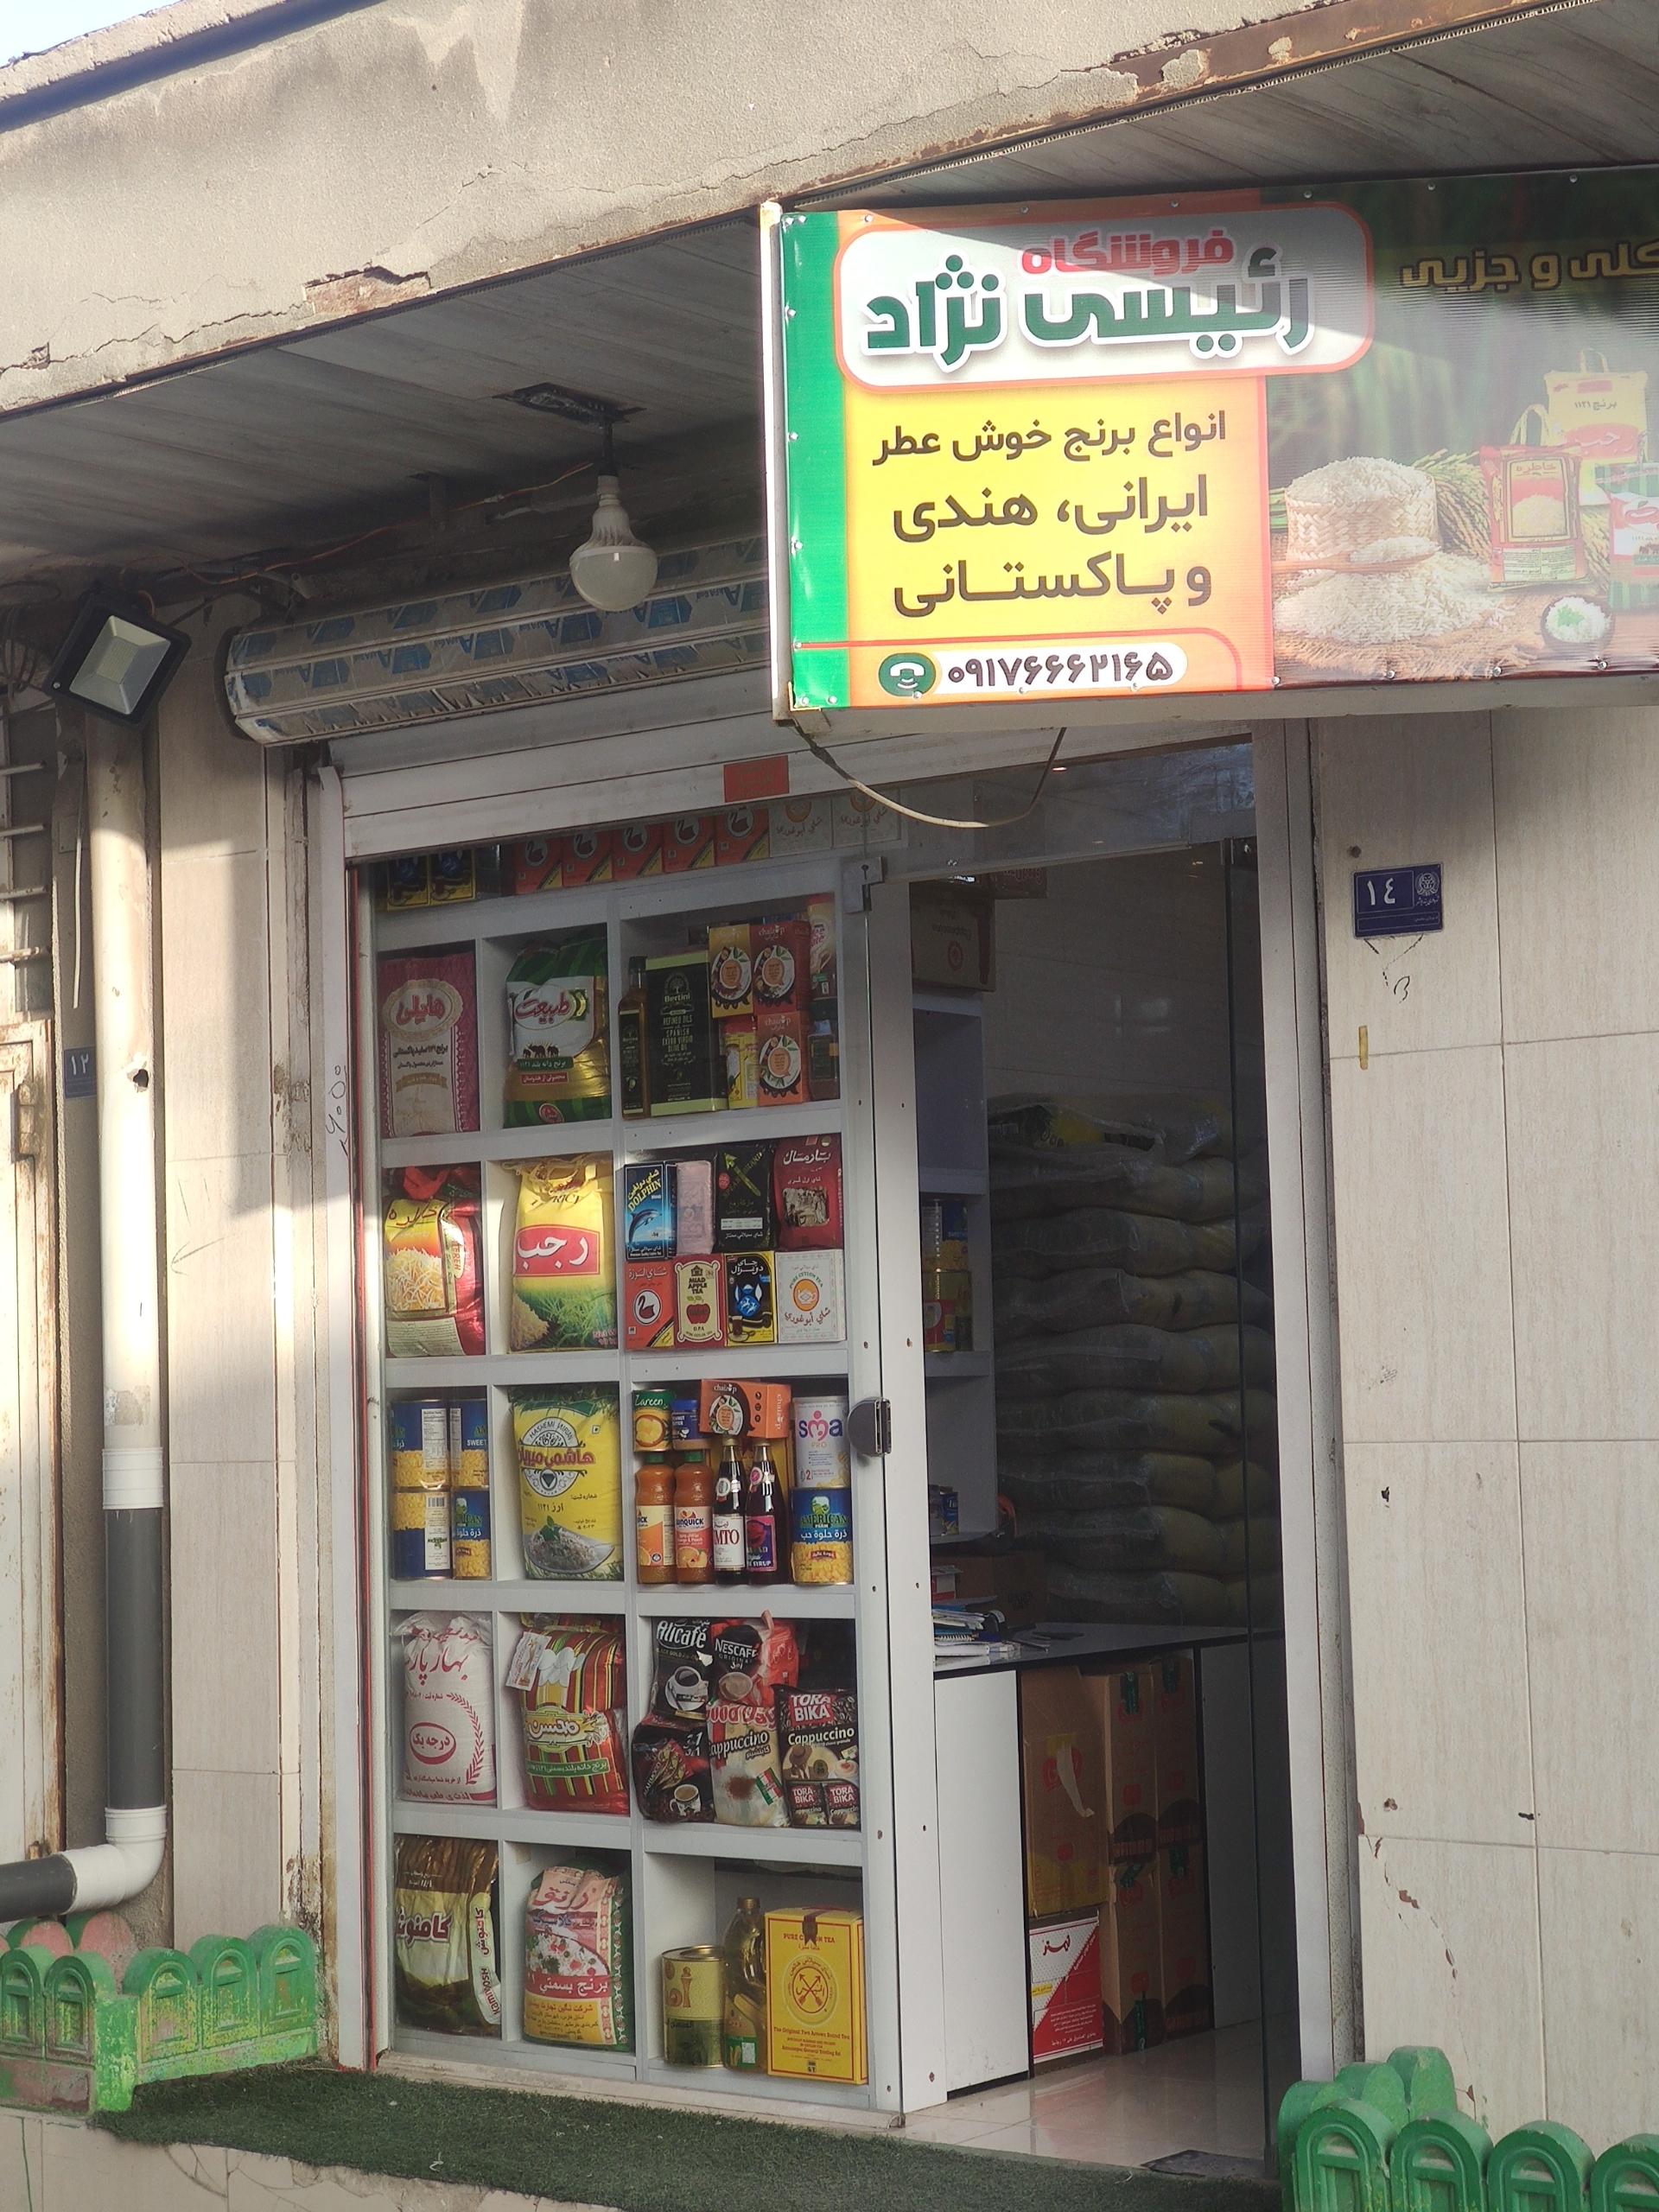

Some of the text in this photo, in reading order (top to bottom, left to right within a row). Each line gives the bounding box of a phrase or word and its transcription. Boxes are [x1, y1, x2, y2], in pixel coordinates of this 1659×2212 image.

[1020, 229, 1236, 276] فروشگاه
[1531, 254, 1560, 290] و
[867, 245, 1313, 365] رئیسی نژاد
[873, 410, 1226, 467] انواع برنج خوش عطر
[893, 487, 1038, 543] هندی
[893, 550, 1212, 618] و پاکستانی
[627, 1178, 662, 1212] DOLPHIN
[518, 1235, 589, 1271] رجب
[834, 1529, 848, 1540] ذرة
[656, 1619, 707, 1649] Alicafé
[429, 1647, 469, 1681] بهار
[791, 1694, 831, 1707] TORA
[794, 1705, 831, 1722] BIKA
[425, 1733, 450, 1751] درجه
[788, 1726, 855, 1747] Cappuccino
[791, 1786, 814, 1796] TORA
[794, 1794, 815, 1804] BIKA
[830, 1784, 855, 1797] TORA
[833, 1793, 855, 1804] BIKA
[783, 1932, 798, 1942] PURE
[576, 1976, 608, 1997] برنج
